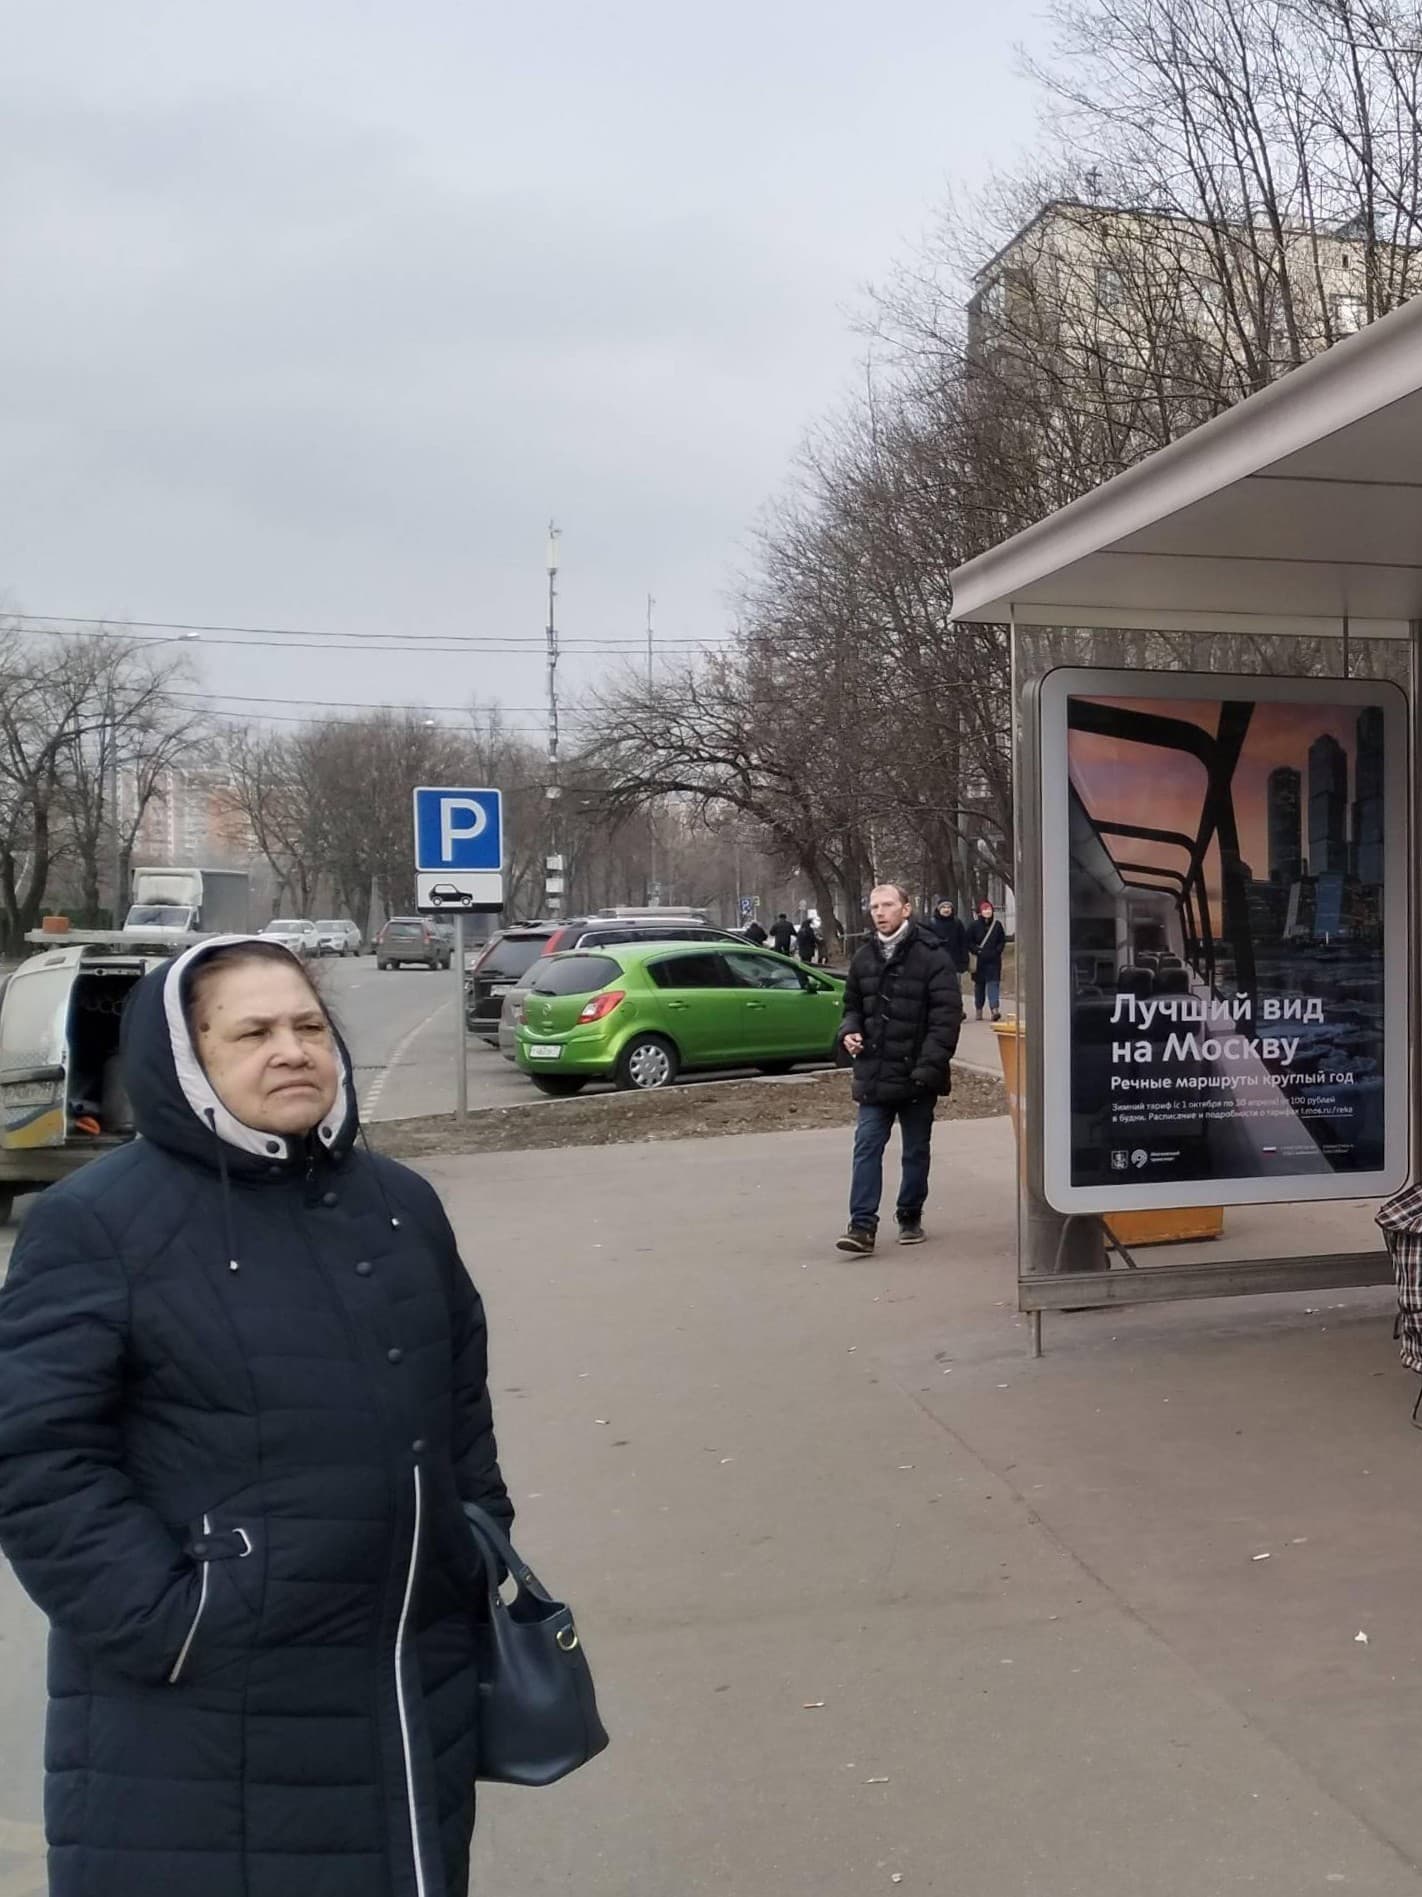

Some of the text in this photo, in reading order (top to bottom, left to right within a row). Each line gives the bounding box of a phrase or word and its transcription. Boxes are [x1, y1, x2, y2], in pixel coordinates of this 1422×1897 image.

[440, 797, 487, 861] P
[1110, 991, 1324, 1030] Лучший вид
[1112, 1032, 1300, 1066] на Москву
[1111, 1071, 1354, 1090] Речные маршруты круглый год
[1146, 1101, 1172, 1110] тариф
